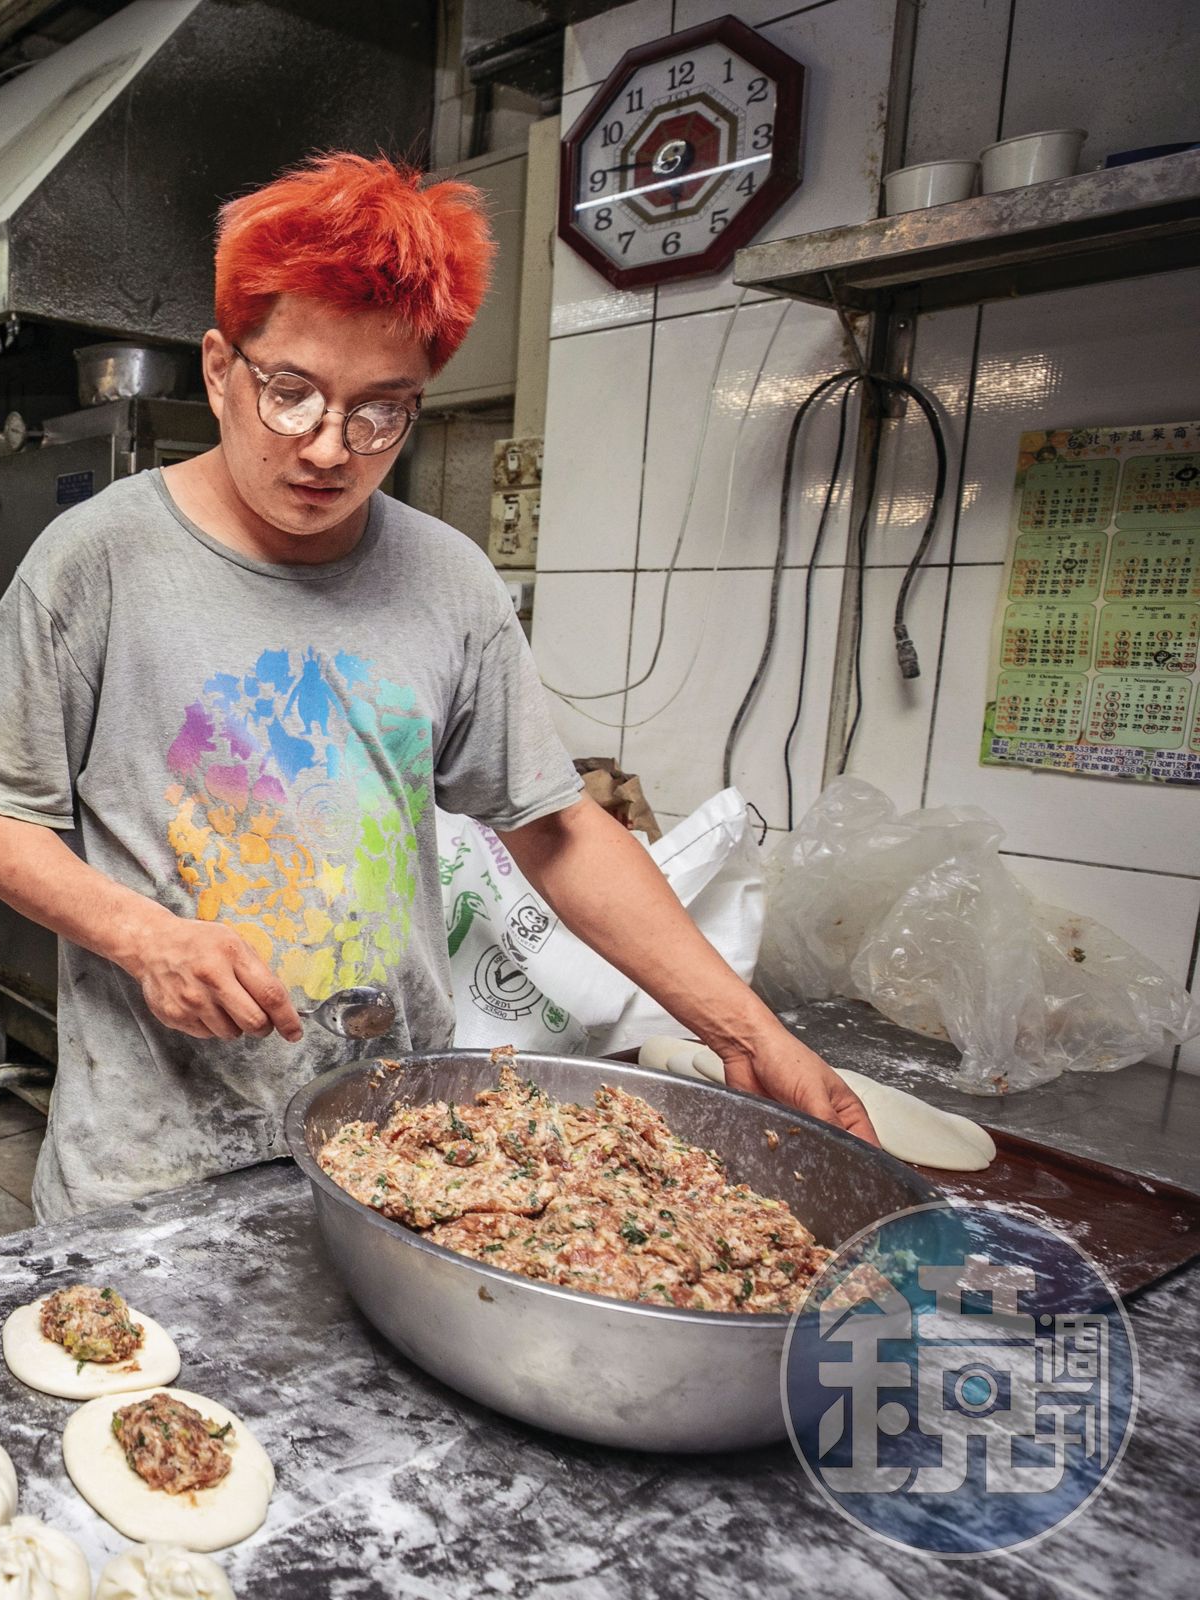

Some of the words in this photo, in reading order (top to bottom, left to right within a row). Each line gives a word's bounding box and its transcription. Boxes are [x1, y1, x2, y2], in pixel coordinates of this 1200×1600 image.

[668, 61, 695, 90] 12
[722, 58, 734, 84] 1
[625, 88, 643, 114] 11
[746, 77, 768, 105] 2
[601, 121, 624, 147] 10
[753, 123, 773, 150] 3
[590, 170, 607, 192] 9
[736, 172, 756, 197] 4
[594, 207, 612, 231] 8
[710, 208, 729, 234] 5
[618, 230, 636, 255] 7
[662, 231, 681, 255] 6
[1067, 425, 1200, 449] 台北市蔬菜商
[473, 820, 512, 876] RAND
